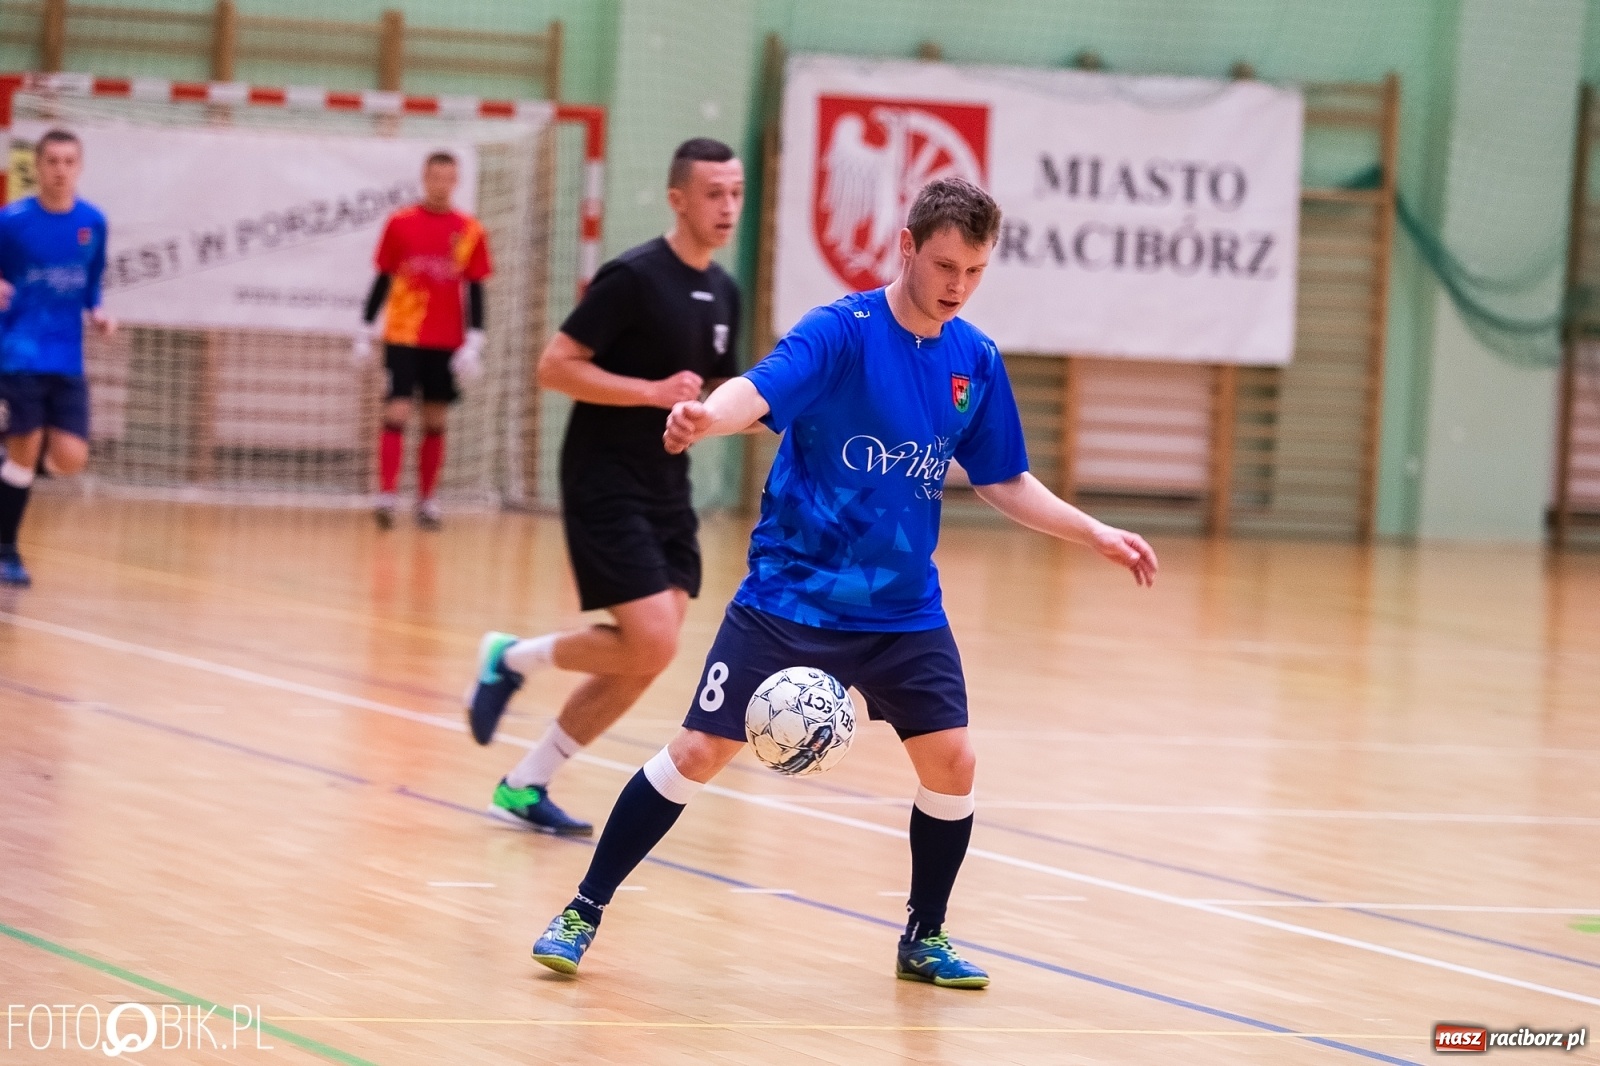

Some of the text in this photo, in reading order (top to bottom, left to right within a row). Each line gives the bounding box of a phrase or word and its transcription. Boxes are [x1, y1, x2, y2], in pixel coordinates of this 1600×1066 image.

[1033, 152, 1248, 212] MIASTO
[998, 212, 1279, 280] RACIBÓRZ
[699, 661, 729, 712] 8
